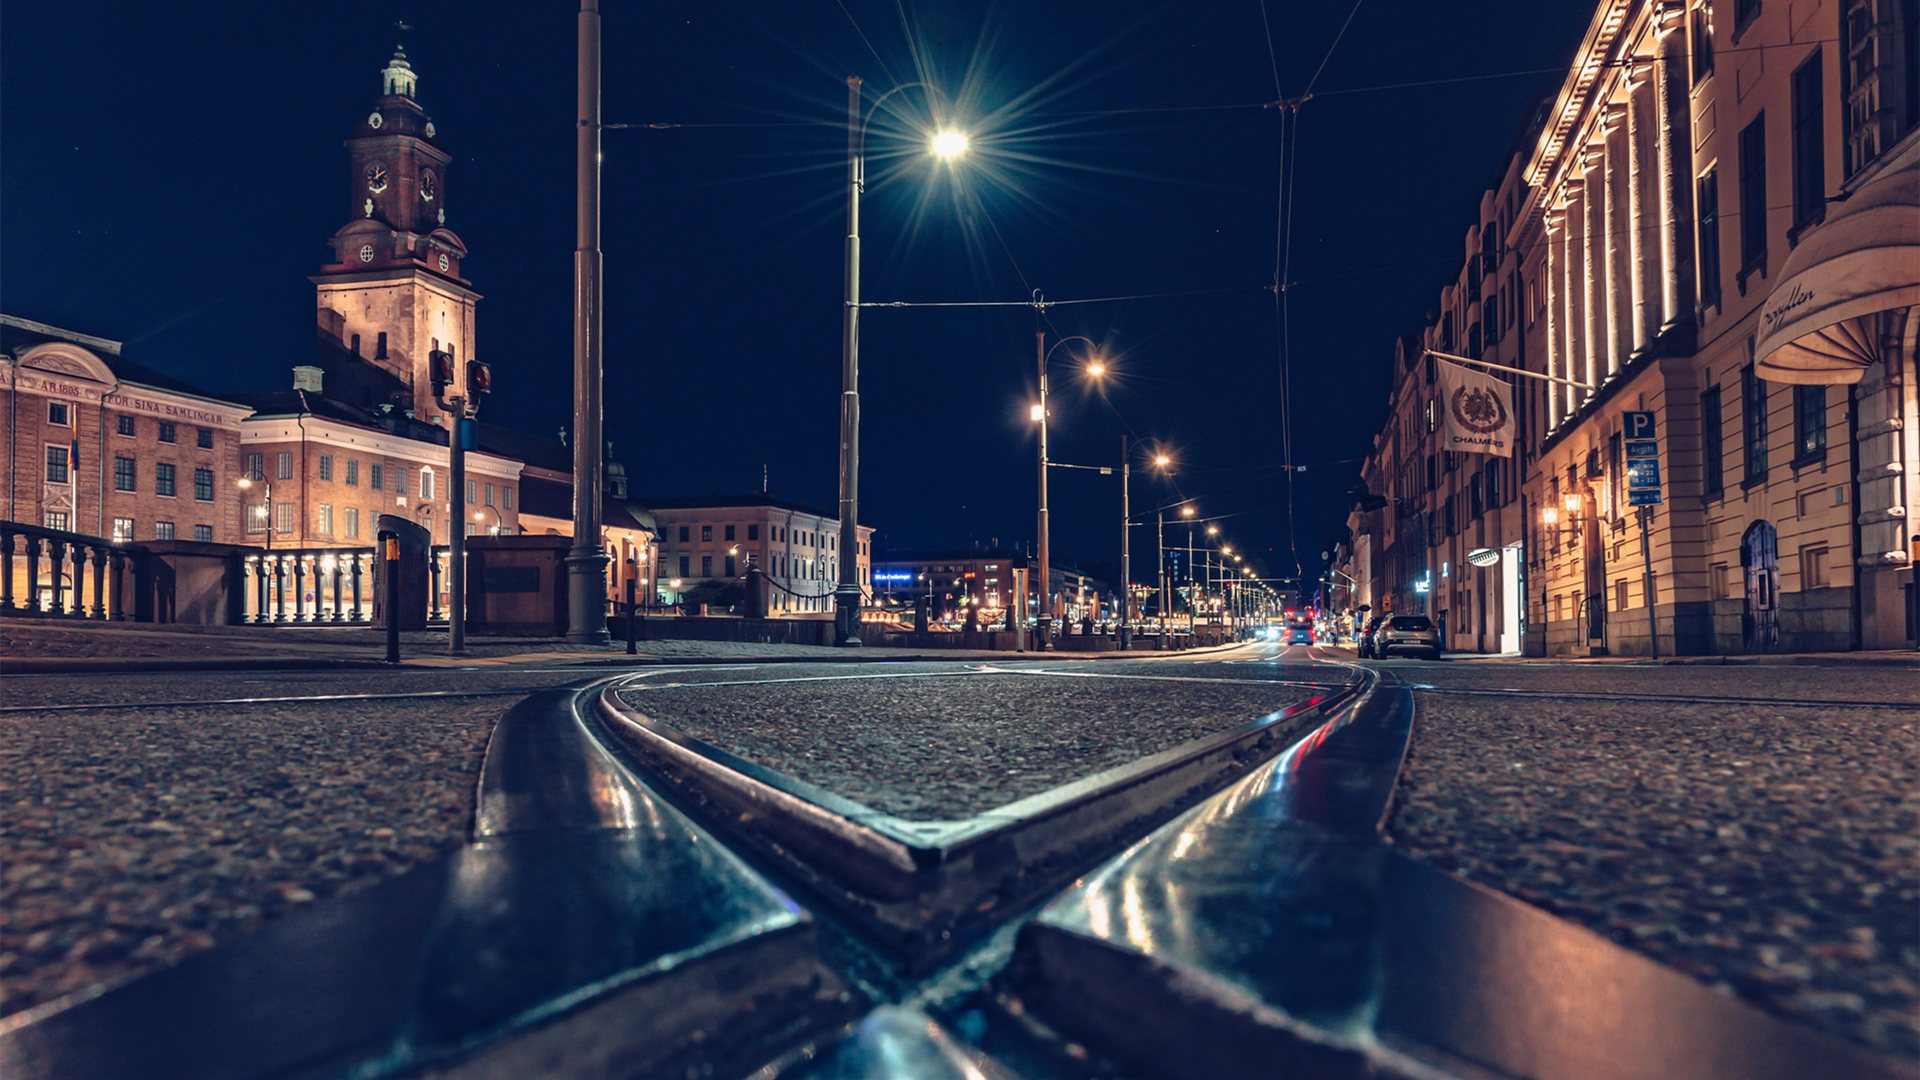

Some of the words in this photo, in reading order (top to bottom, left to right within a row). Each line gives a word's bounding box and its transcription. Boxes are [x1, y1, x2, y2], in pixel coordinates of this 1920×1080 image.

[59, 384, 80, 397] 1895
[134, 399, 160, 413] SINA
[166, 406, 223, 424] SAMLINGAR
[1632, 413, 1648, 437] P
[1453, 435, 1505, 448] CHALMERS
[1631, 445, 1654, 455] Avgift
